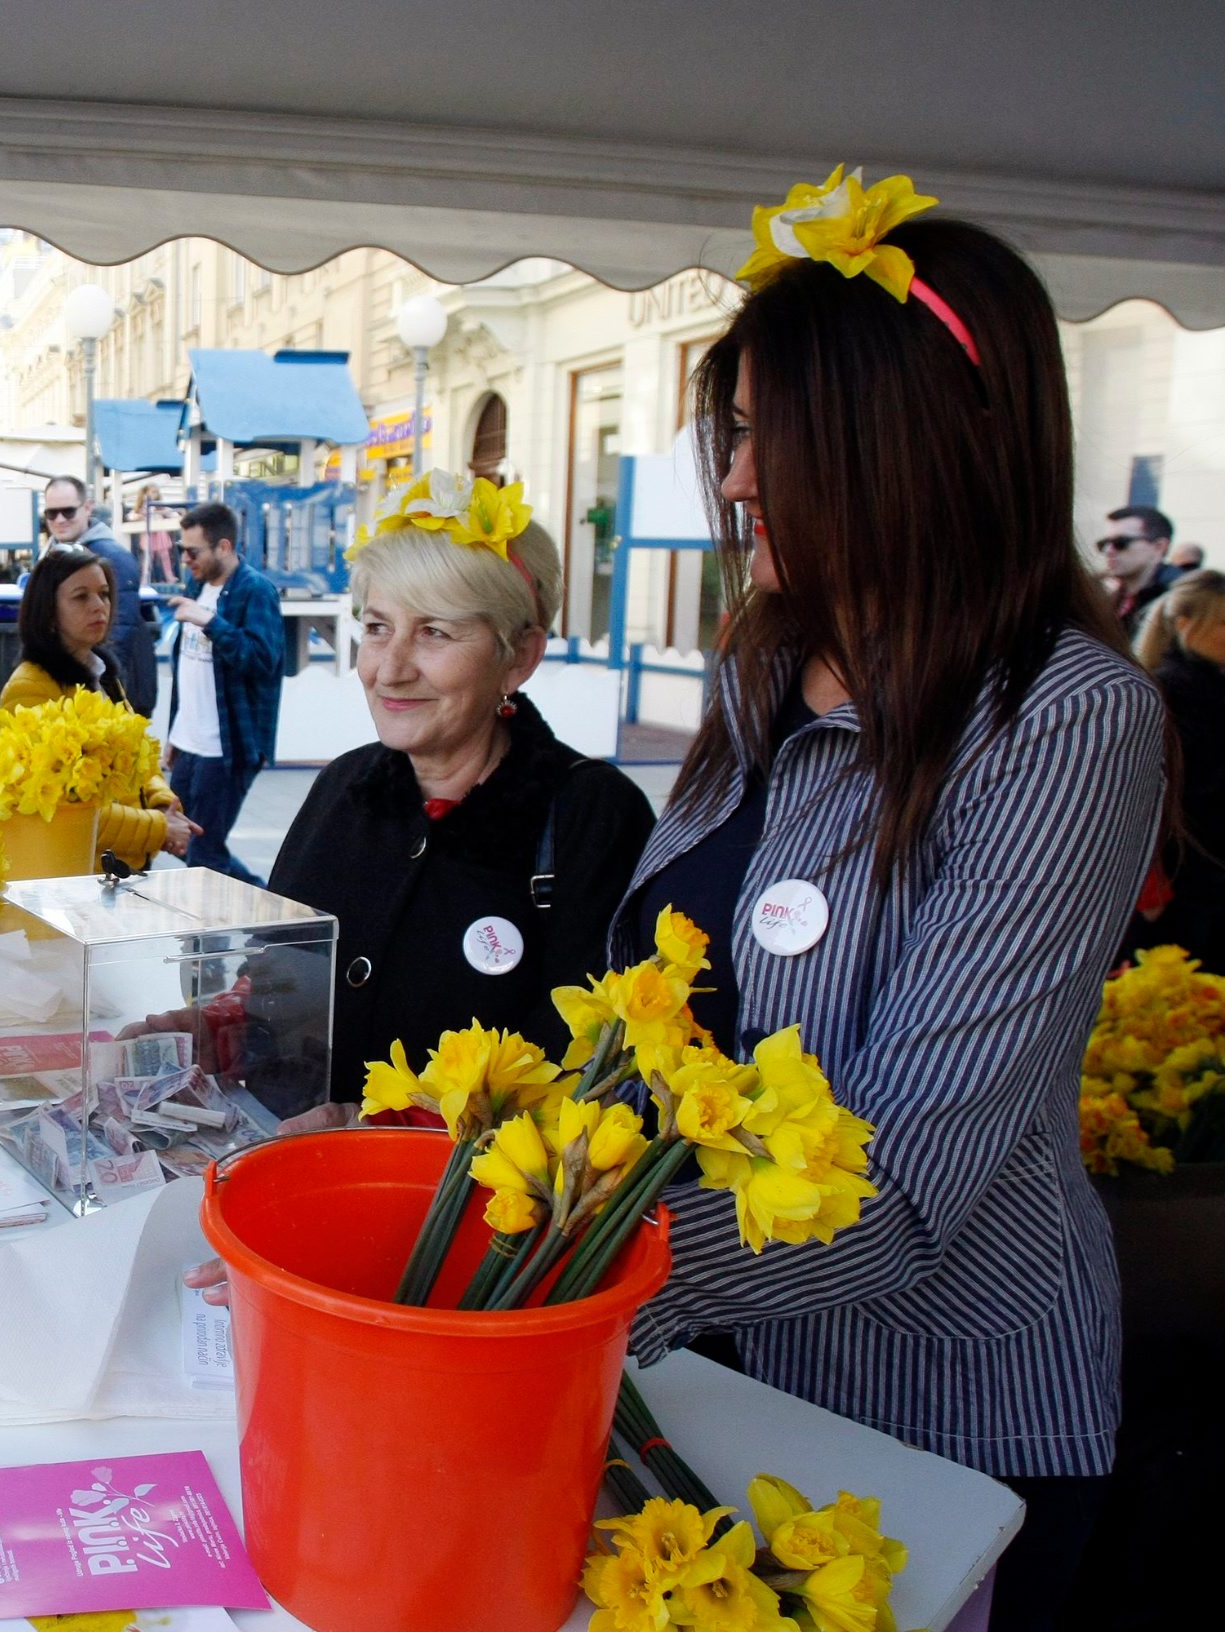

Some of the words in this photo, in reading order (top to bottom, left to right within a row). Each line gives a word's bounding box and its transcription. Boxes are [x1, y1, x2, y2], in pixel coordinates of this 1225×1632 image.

[762, 903, 794, 920] PINK
[483, 925, 501, 949] PINK
[69, 1498, 138, 1576] PINK
